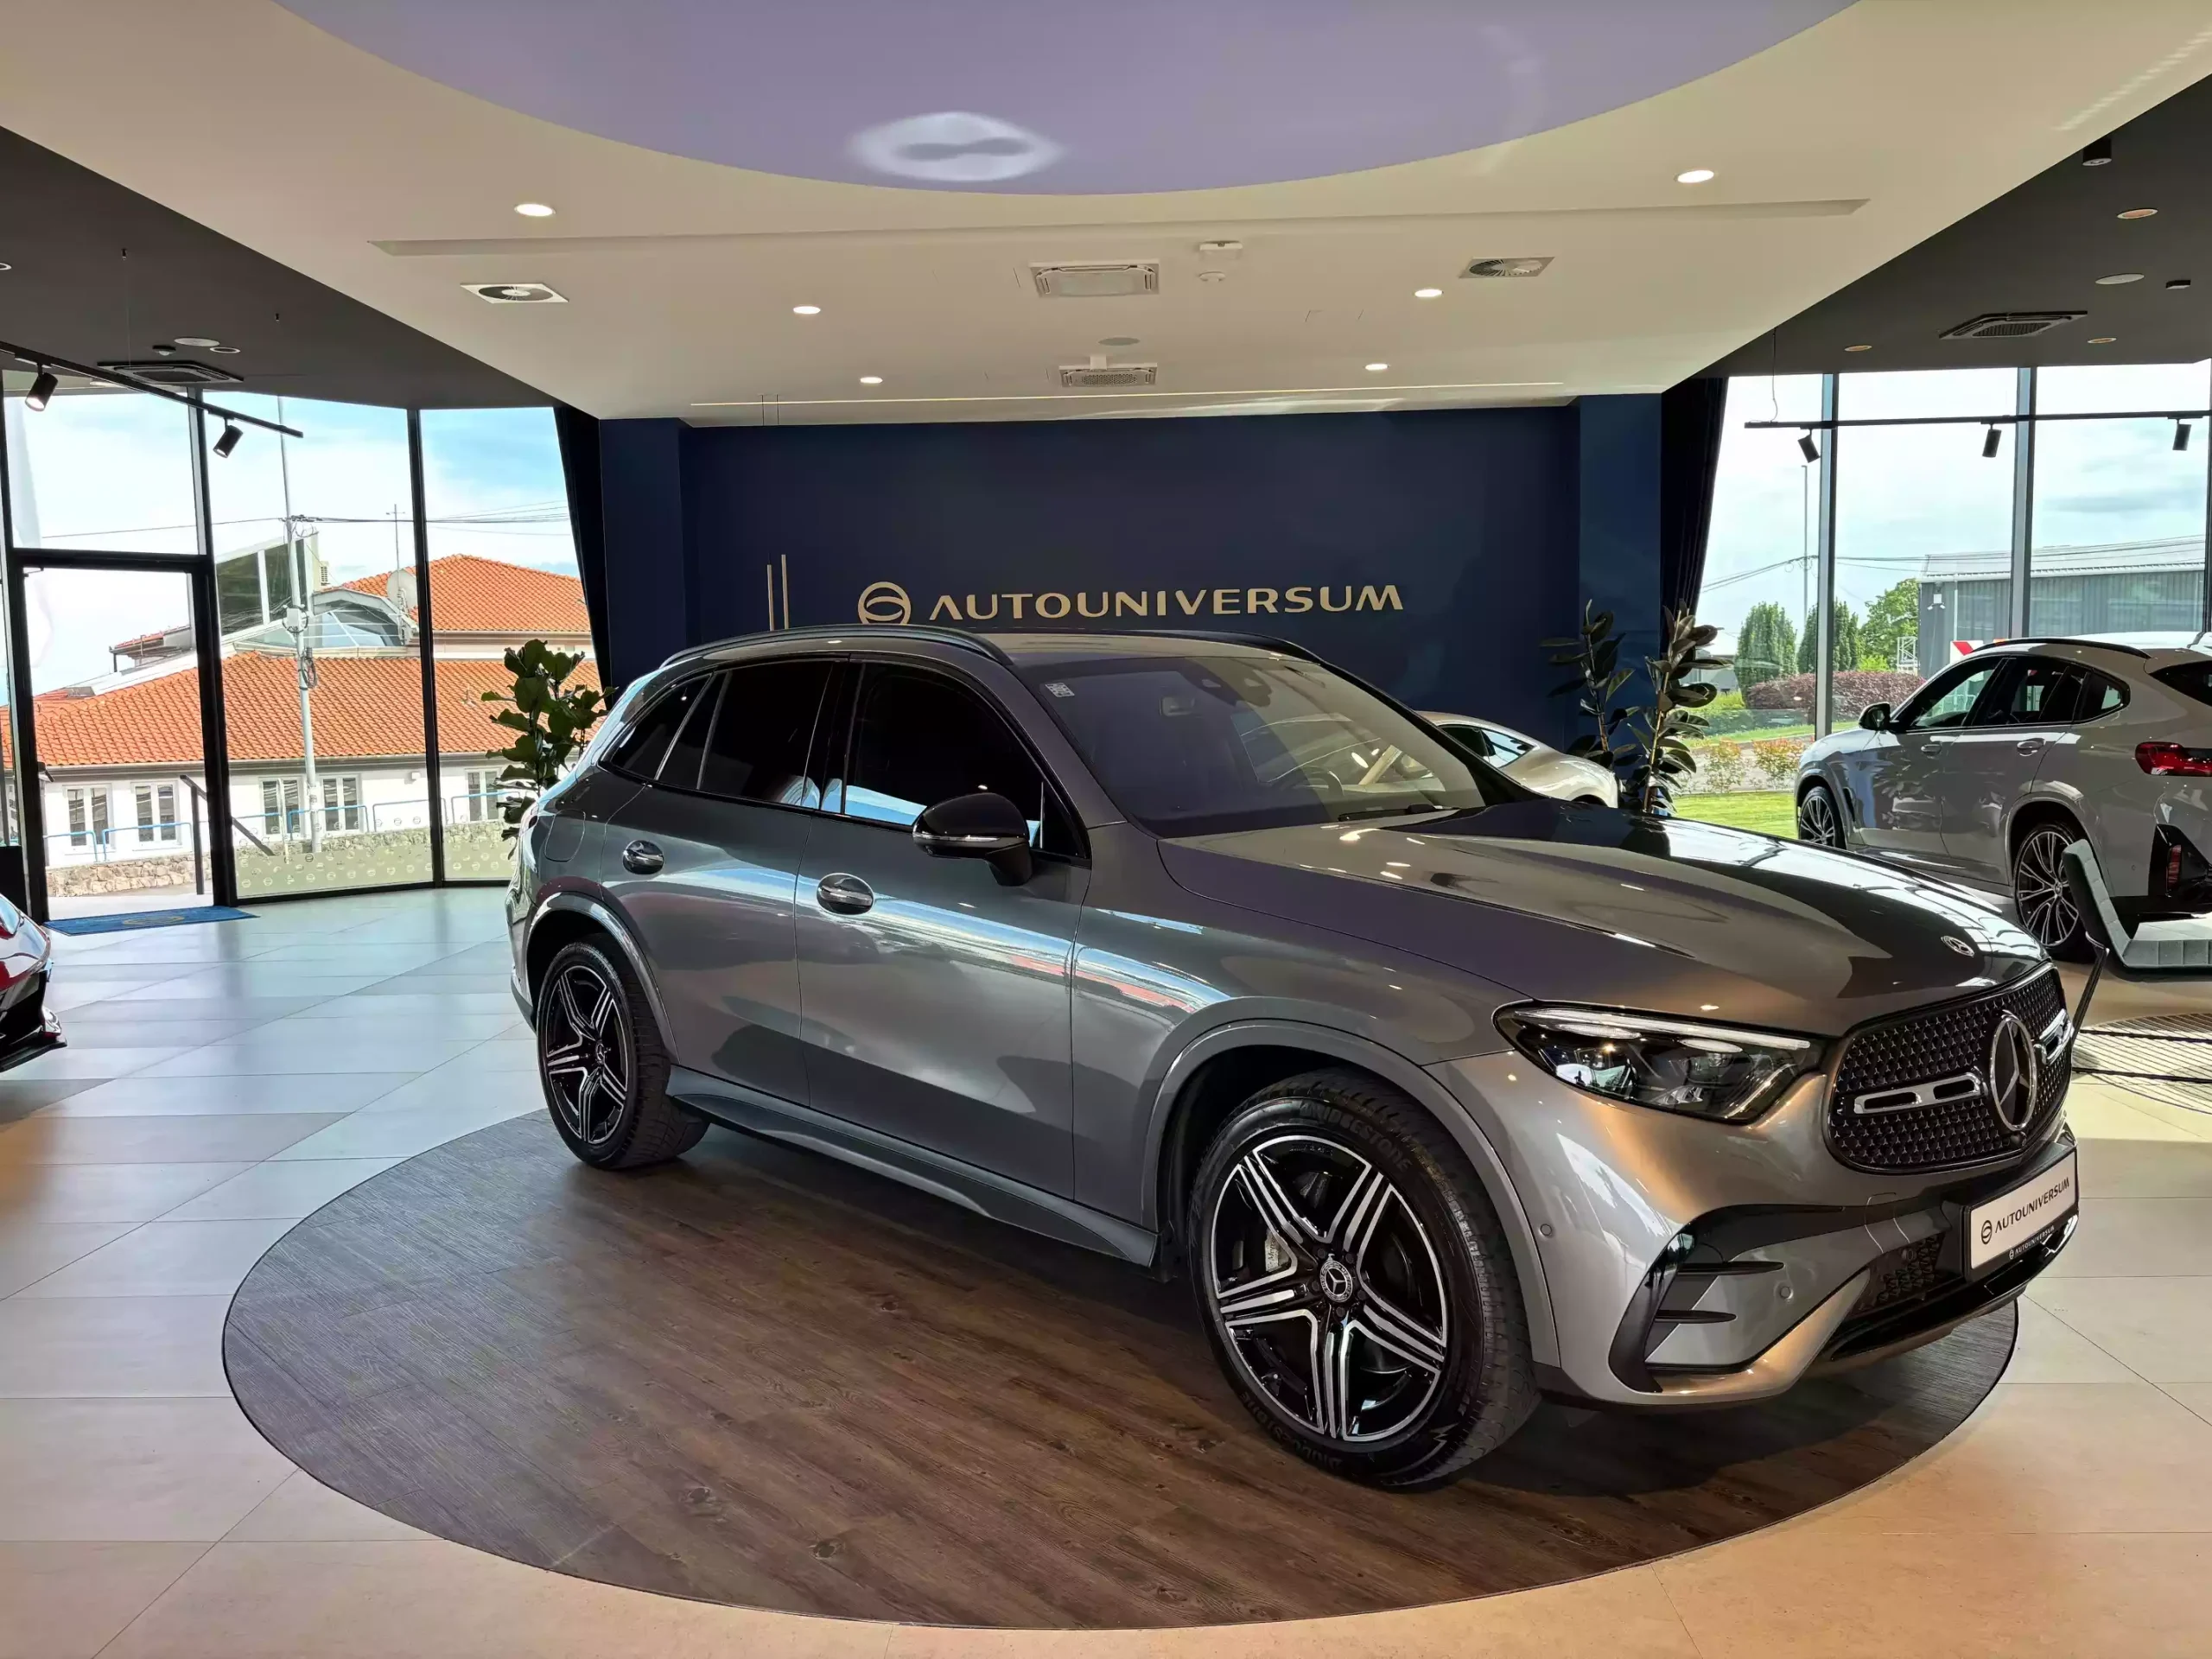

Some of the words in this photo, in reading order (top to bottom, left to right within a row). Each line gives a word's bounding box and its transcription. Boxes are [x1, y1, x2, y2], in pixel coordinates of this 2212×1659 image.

[930, 584, 1404, 620] AUTOUNIVERSUM
[1995, 1177, 2069, 1233] AUTOUNIVERSUM
[2015, 1225, 2054, 1255] AUTOUNIVERSUM
